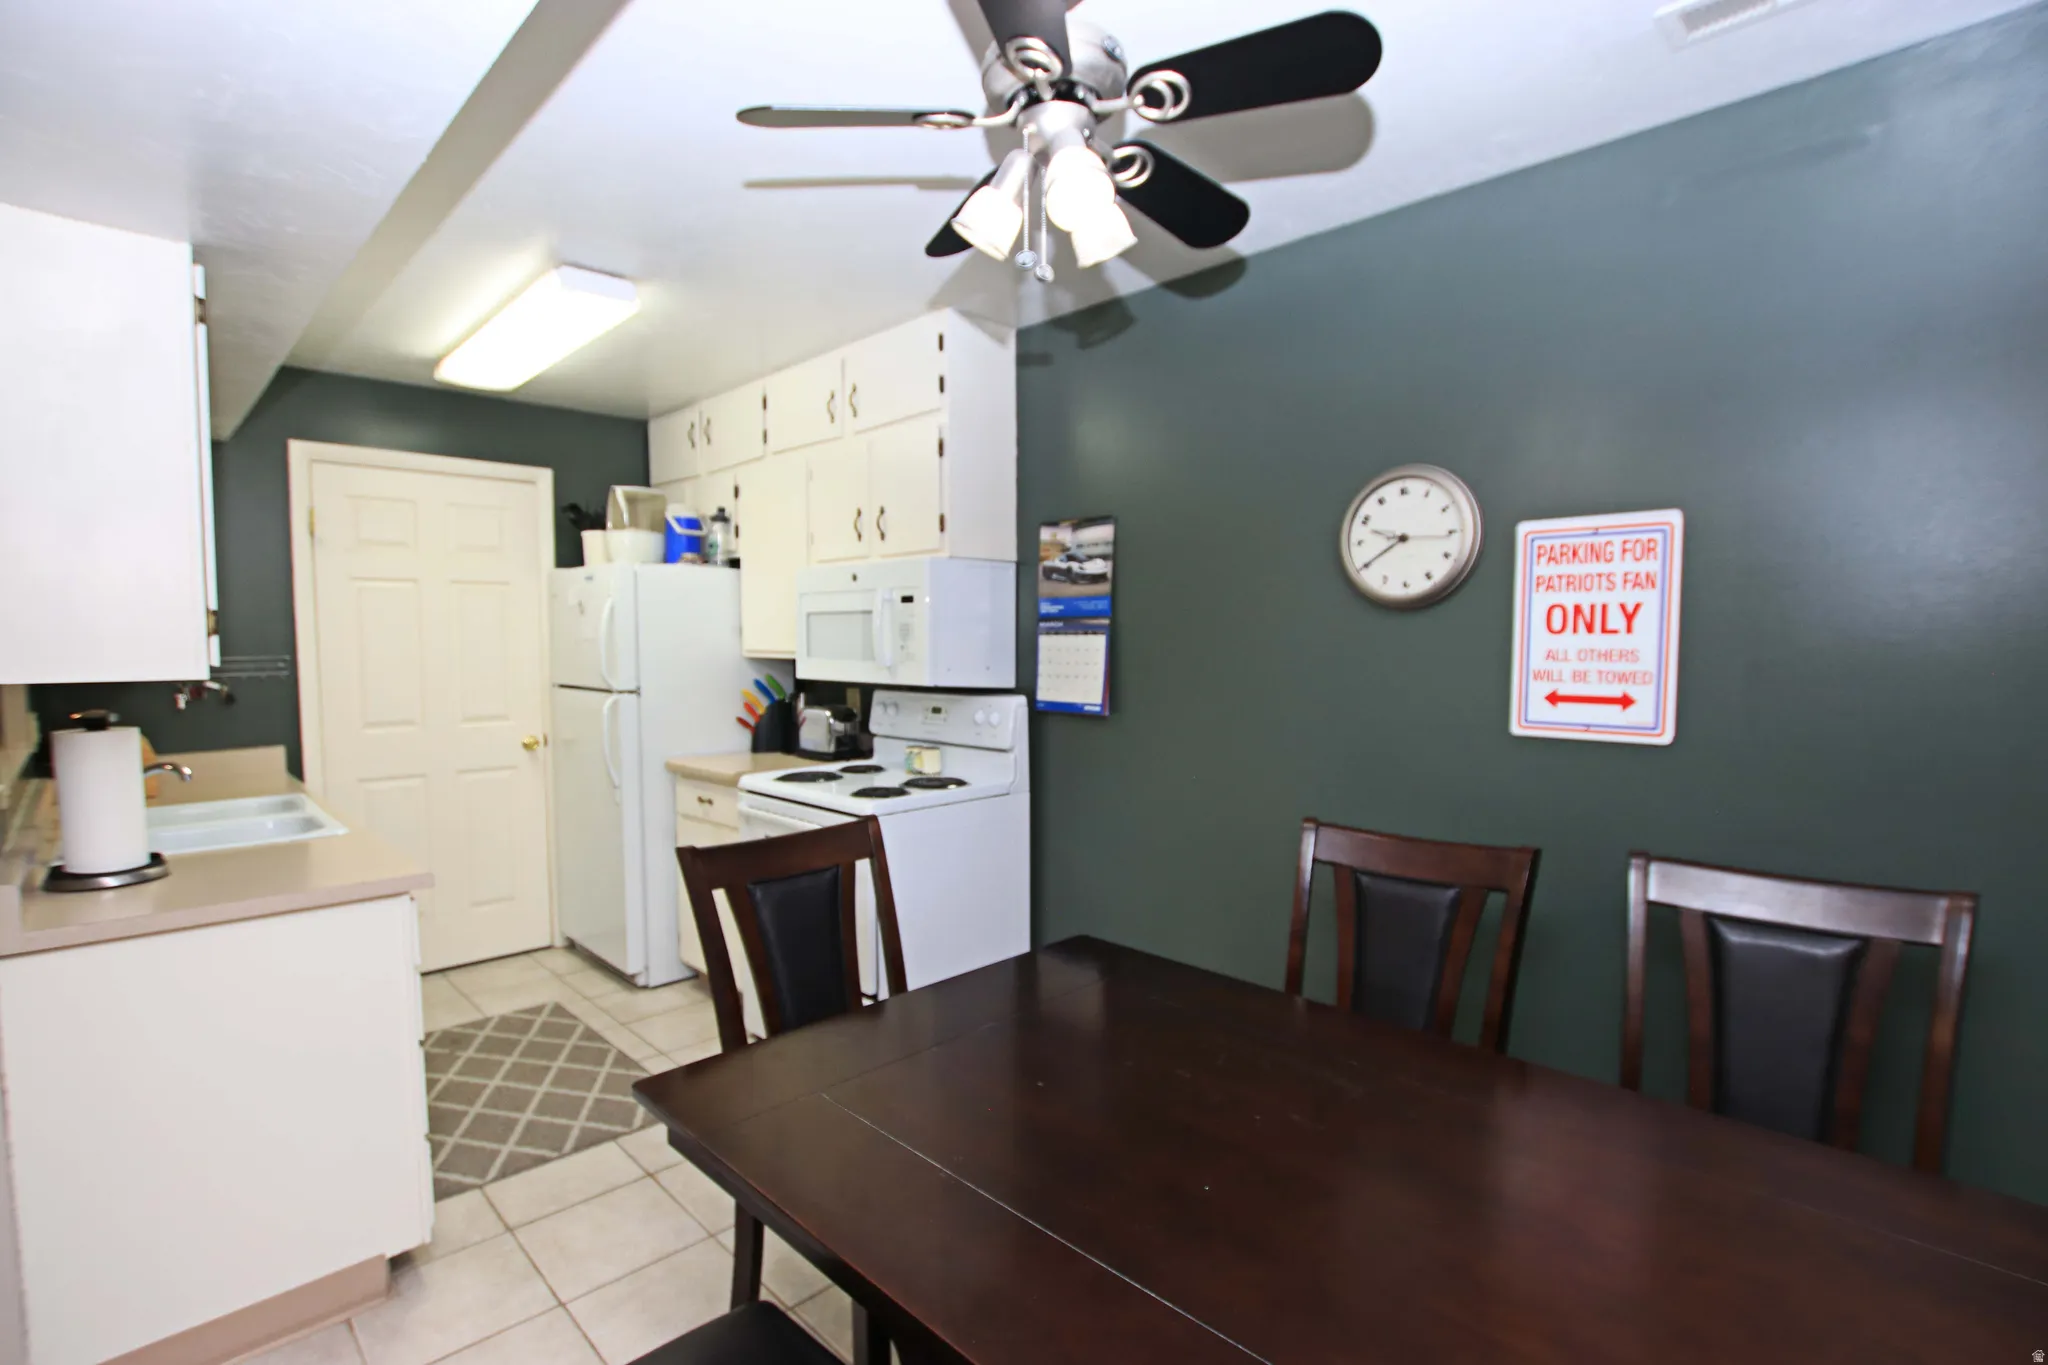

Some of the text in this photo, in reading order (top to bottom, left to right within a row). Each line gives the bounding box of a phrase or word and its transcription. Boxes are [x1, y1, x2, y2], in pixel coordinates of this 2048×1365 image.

[1536, 538, 1658, 566] PARKING FOR
[1535, 570, 1657, 592] PATRIOTS FAN
[1546, 602, 1644, 634] ONLY
[1545, 648, 1640, 663] ALL OTHERS
[1532, 669, 1653, 685] WILL BE TOWED
